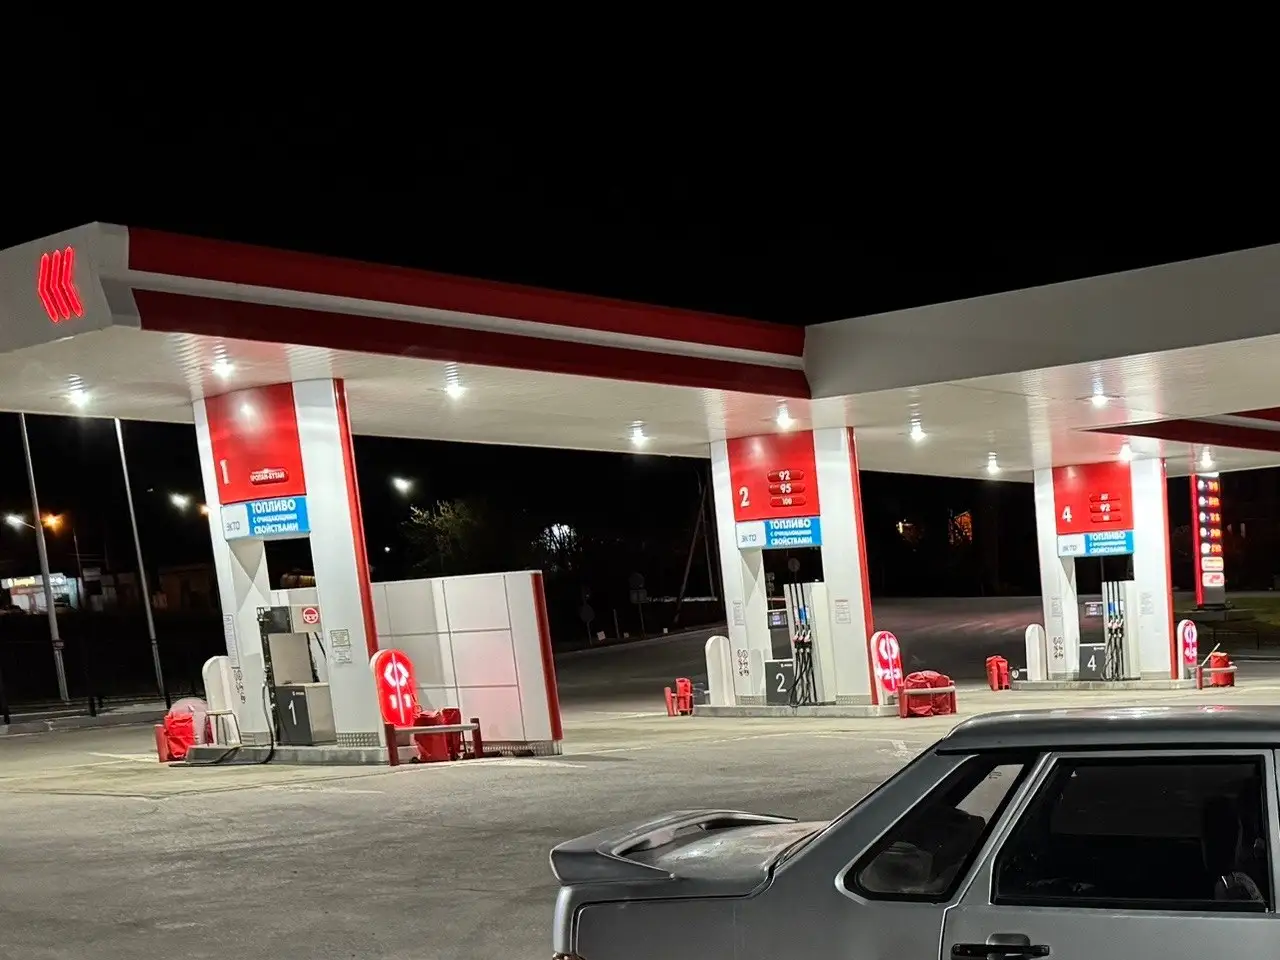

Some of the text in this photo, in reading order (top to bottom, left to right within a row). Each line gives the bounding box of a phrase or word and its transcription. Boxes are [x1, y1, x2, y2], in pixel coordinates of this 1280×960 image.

[220, 459, 229, 484] 1
[779, 470, 791, 480] 92
[780, 483, 792, 493] 95
[739, 486, 750, 507] 2
[251, 499, 296, 513] ТОПЛИВО
[1062, 505, 1072, 523] 4
[769, 518, 811, 529] ТОПЛИВО
[1087, 655, 1097, 671] 4
[776, 673, 786, 692] 2
[389, 694, 398, 709] 1
[288, 700, 297, 725] 1
